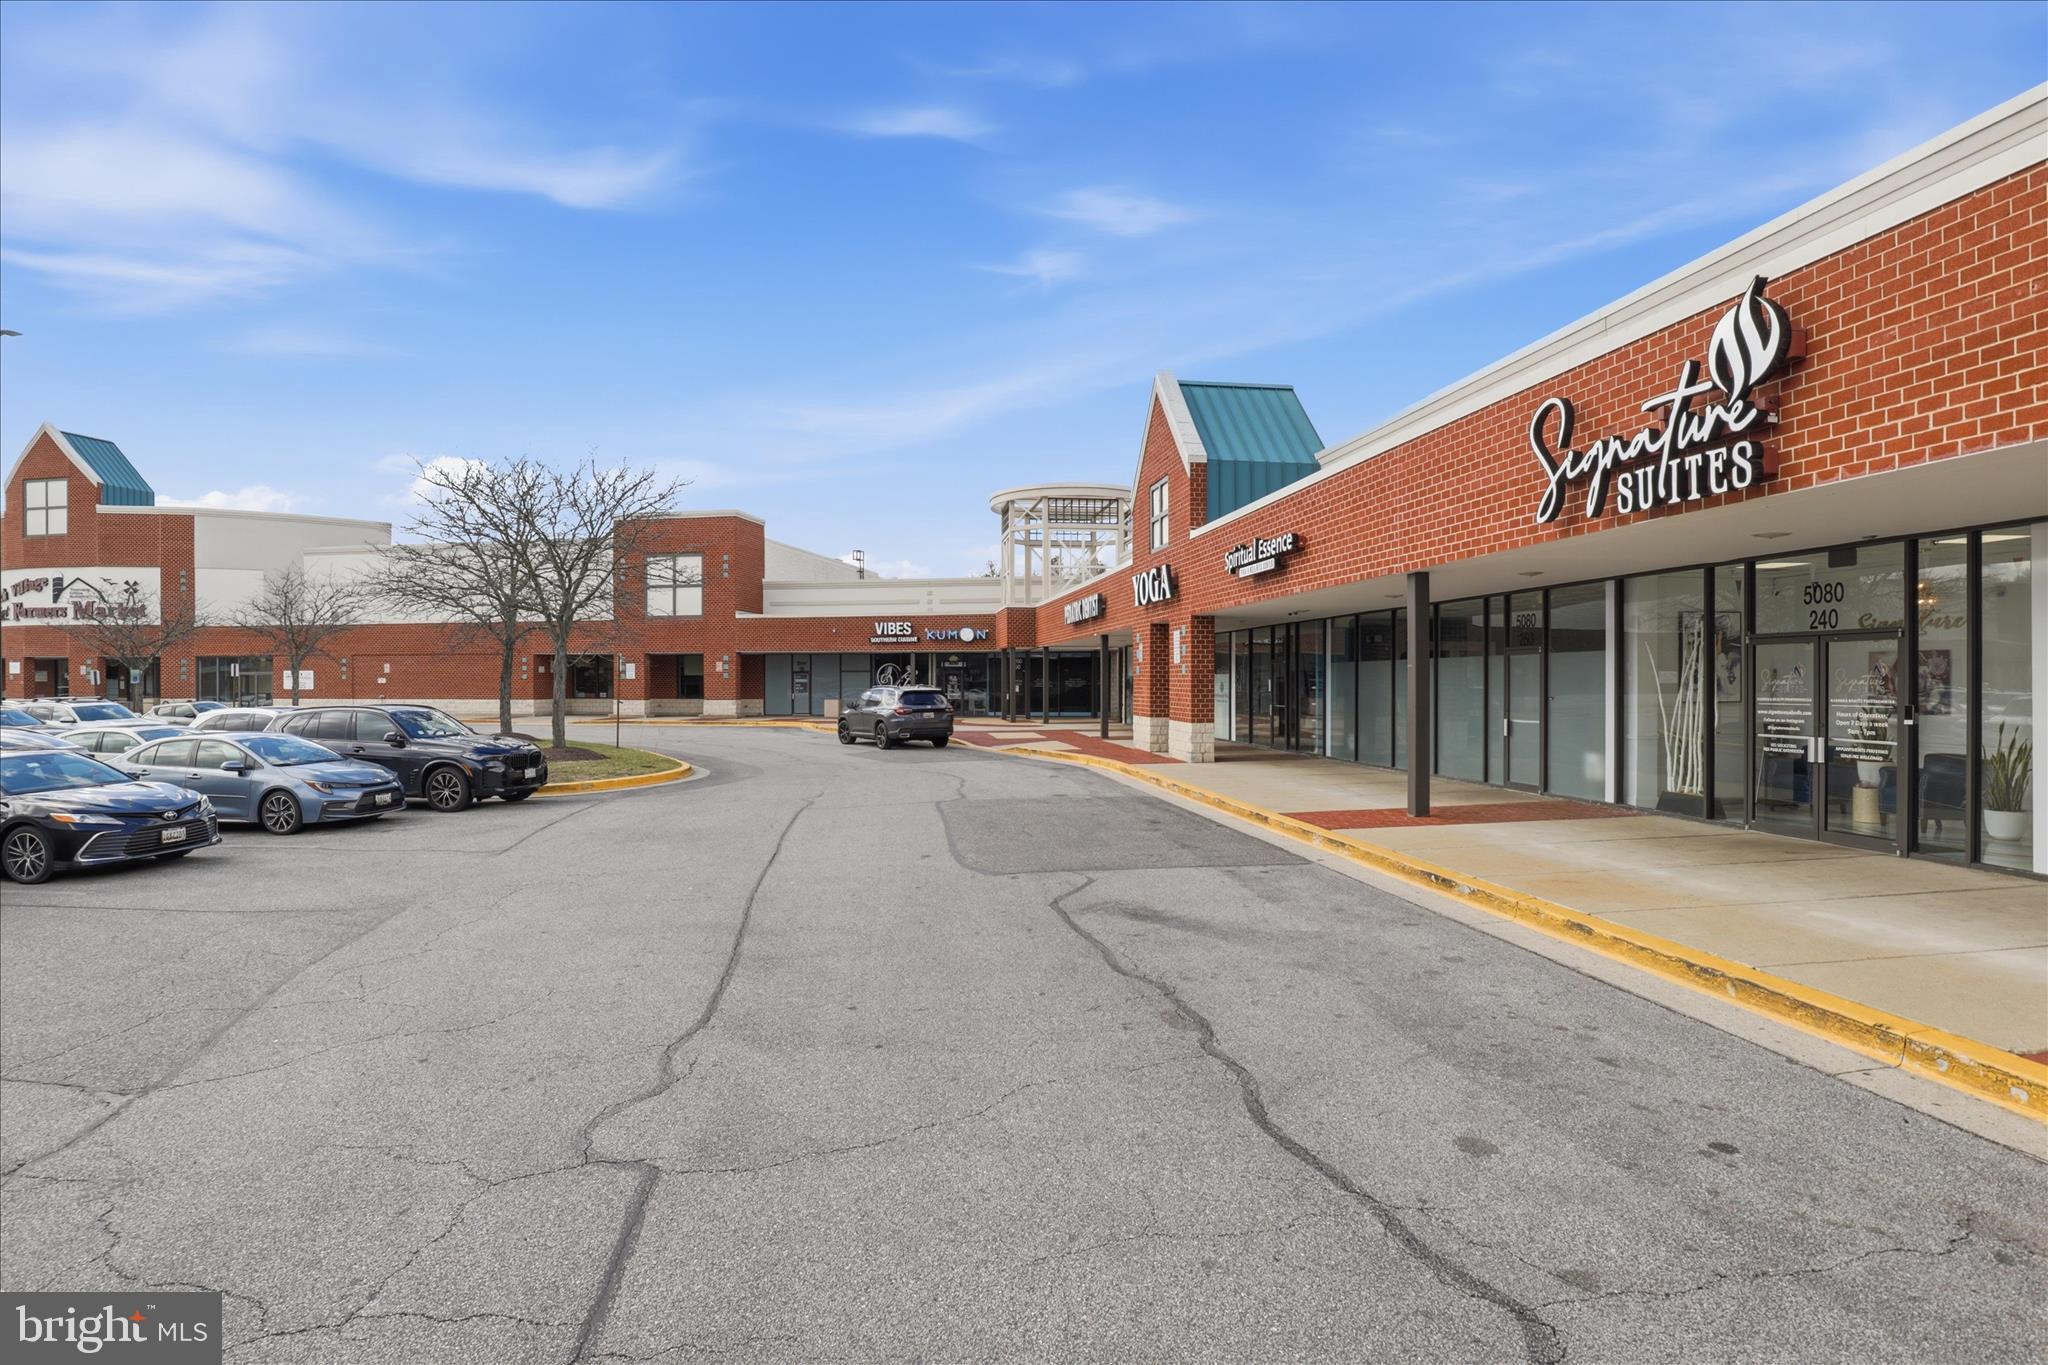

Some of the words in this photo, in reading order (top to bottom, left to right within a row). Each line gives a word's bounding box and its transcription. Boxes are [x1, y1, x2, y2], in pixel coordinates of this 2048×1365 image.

[1530, 360, 1757, 523] Signature
[1617, 441, 1754, 514] SUITES
[1225, 538, 1256, 574] Spiritual
[1258, 533, 1293, 559] Essence
[11, 577, 48, 597] Village
[1132, 565, 1171, 606] YOGA
[1803, 582, 1844, 605] 5080
[12, 602, 67, 622] Farmers
[71, 600, 147, 621] Market
[1809, 608, 1838, 629] 240
[875, 622, 912, 635] VIBES
